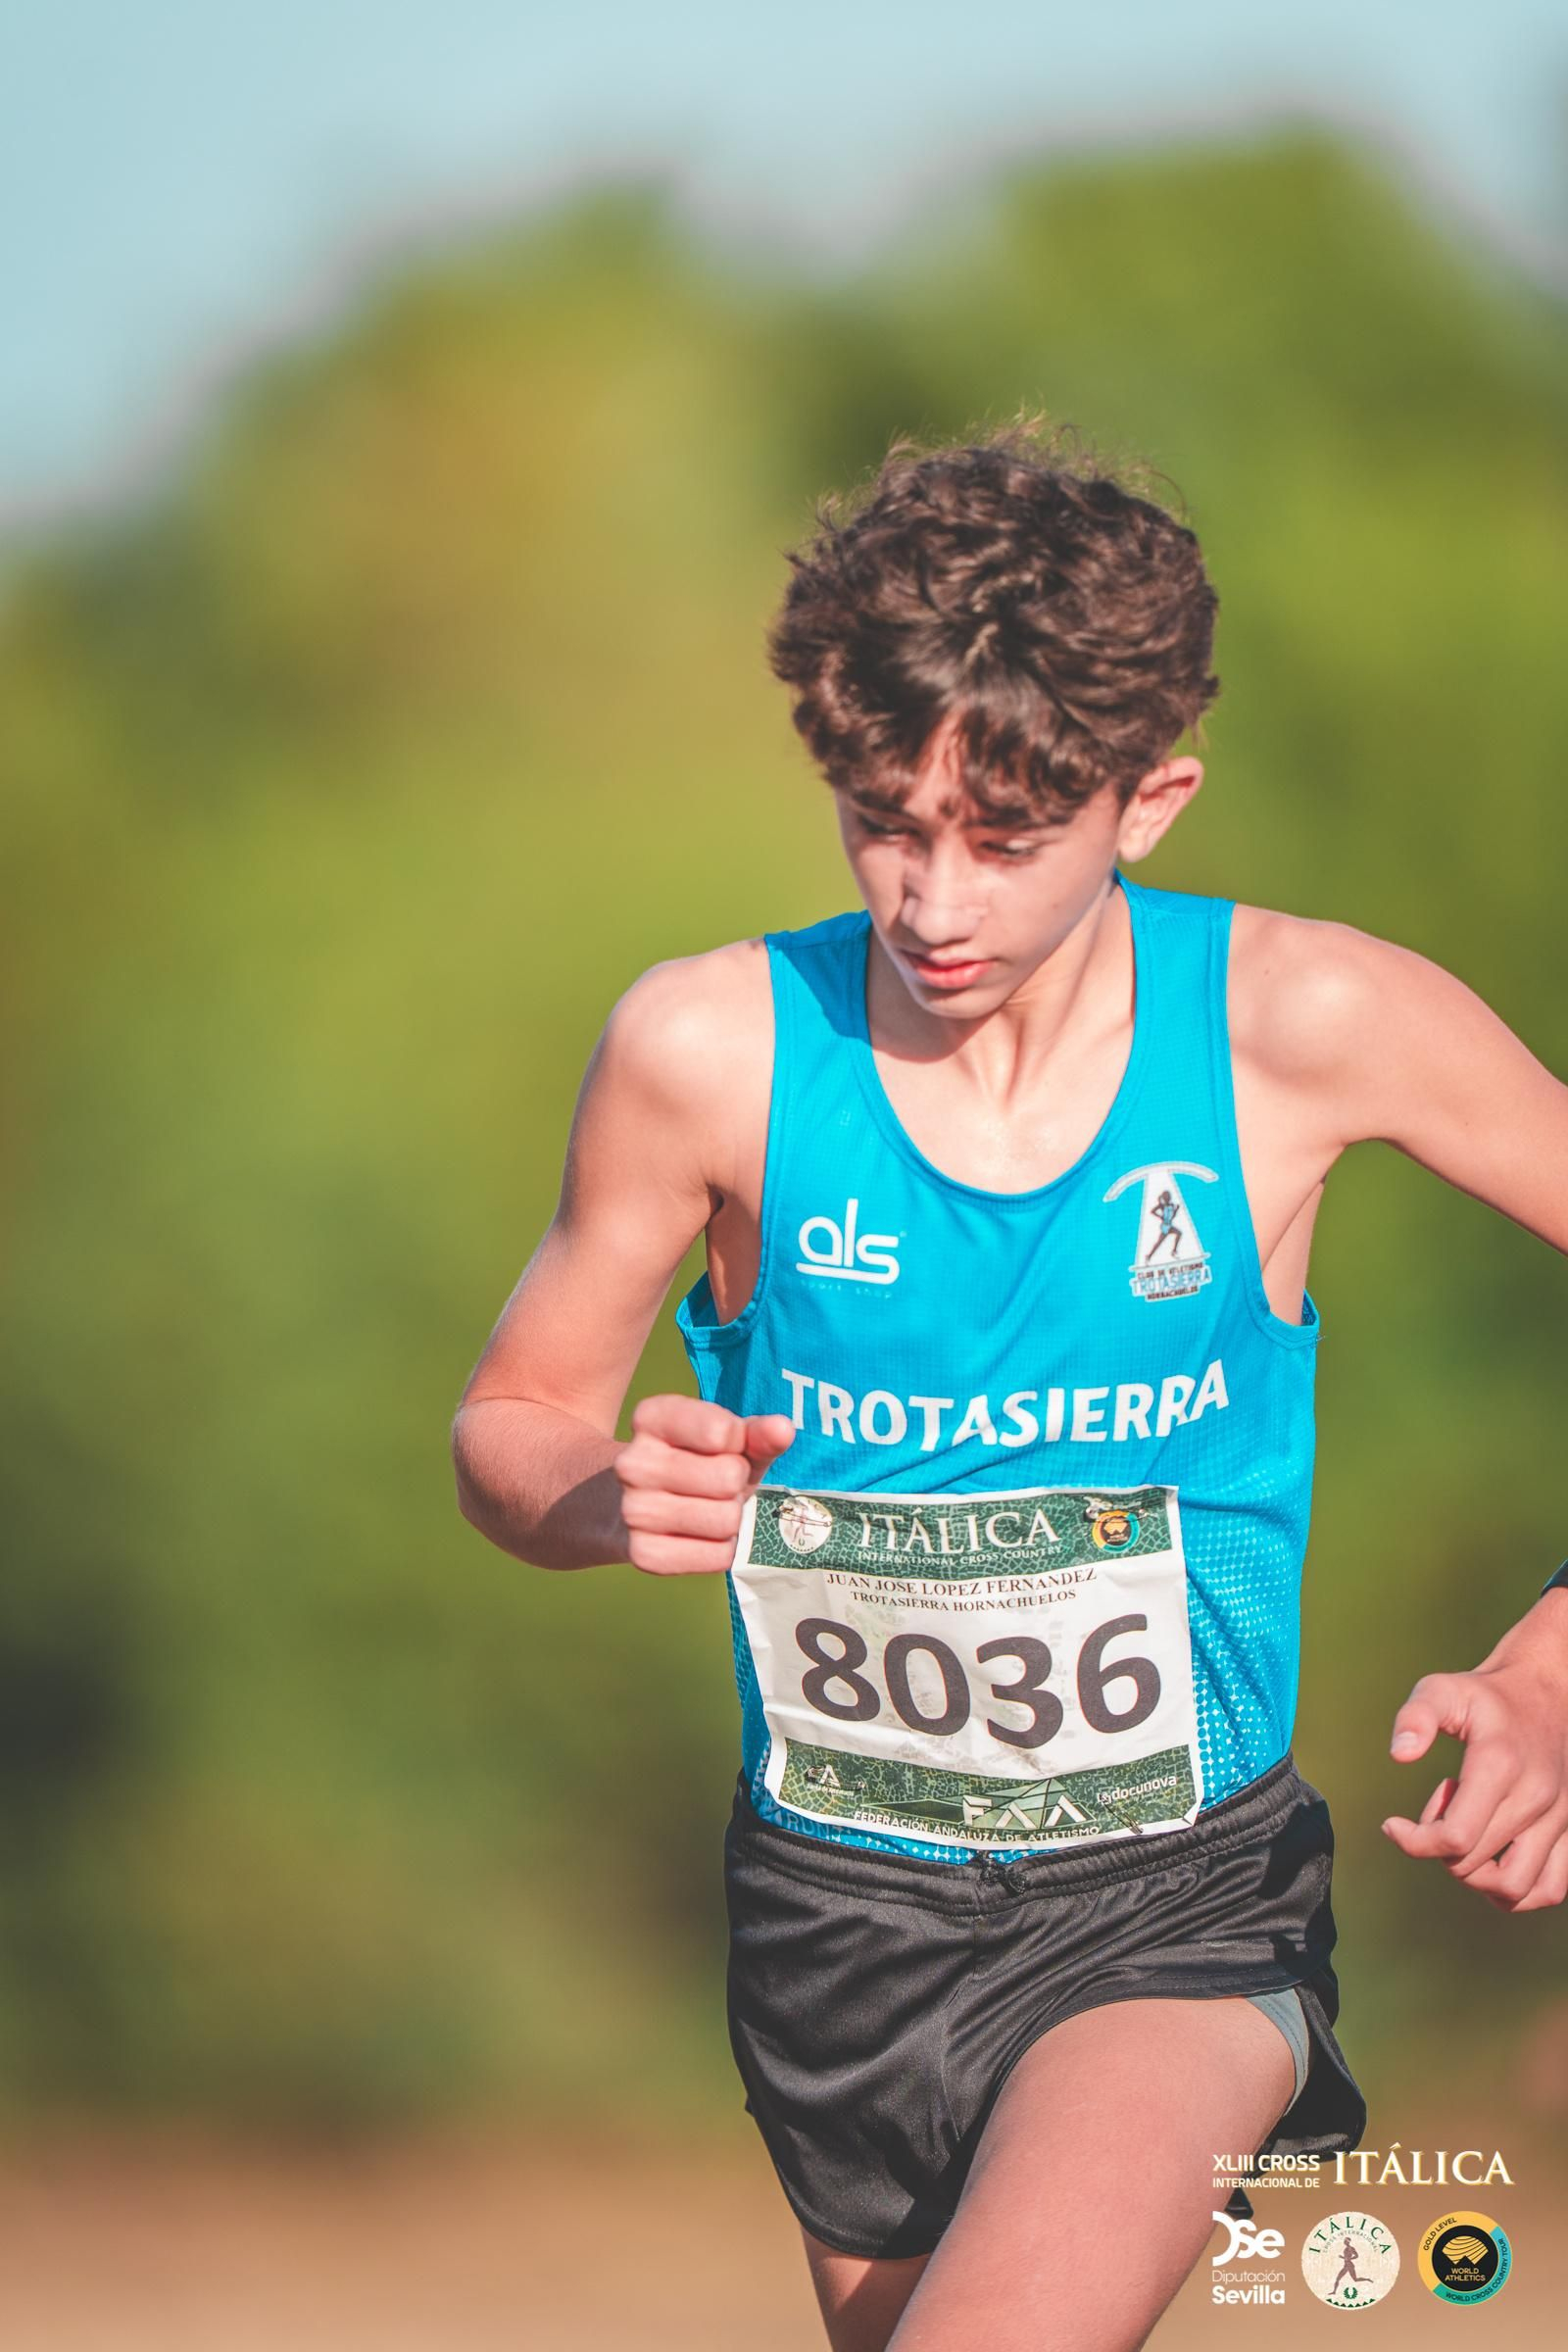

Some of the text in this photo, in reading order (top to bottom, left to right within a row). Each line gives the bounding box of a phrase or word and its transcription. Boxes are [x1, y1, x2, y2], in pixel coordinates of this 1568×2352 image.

[796, 1198, 901, 1285] als
[1132, 1268, 1211, 1295] TROTASIERRA
[781, 1358, 1229, 1451] TROTASIERRA
[857, 1507, 1061, 1554] ITÁLICA
[858, 1544, 1062, 1567] INTERNATIONAL CROSS COUNTRY
[827, 1567, 1098, 1596] JUAN JOSE LOPEZ FERNANDEZ
[851, 1589, 1076, 1612] TROTASIERRA HORNACHUELOS
[795, 1613, 1161, 1749] 8036
[854, 1811, 1100, 1842] FEDERACIÓN ANDALUZA DE ATLETISMO
